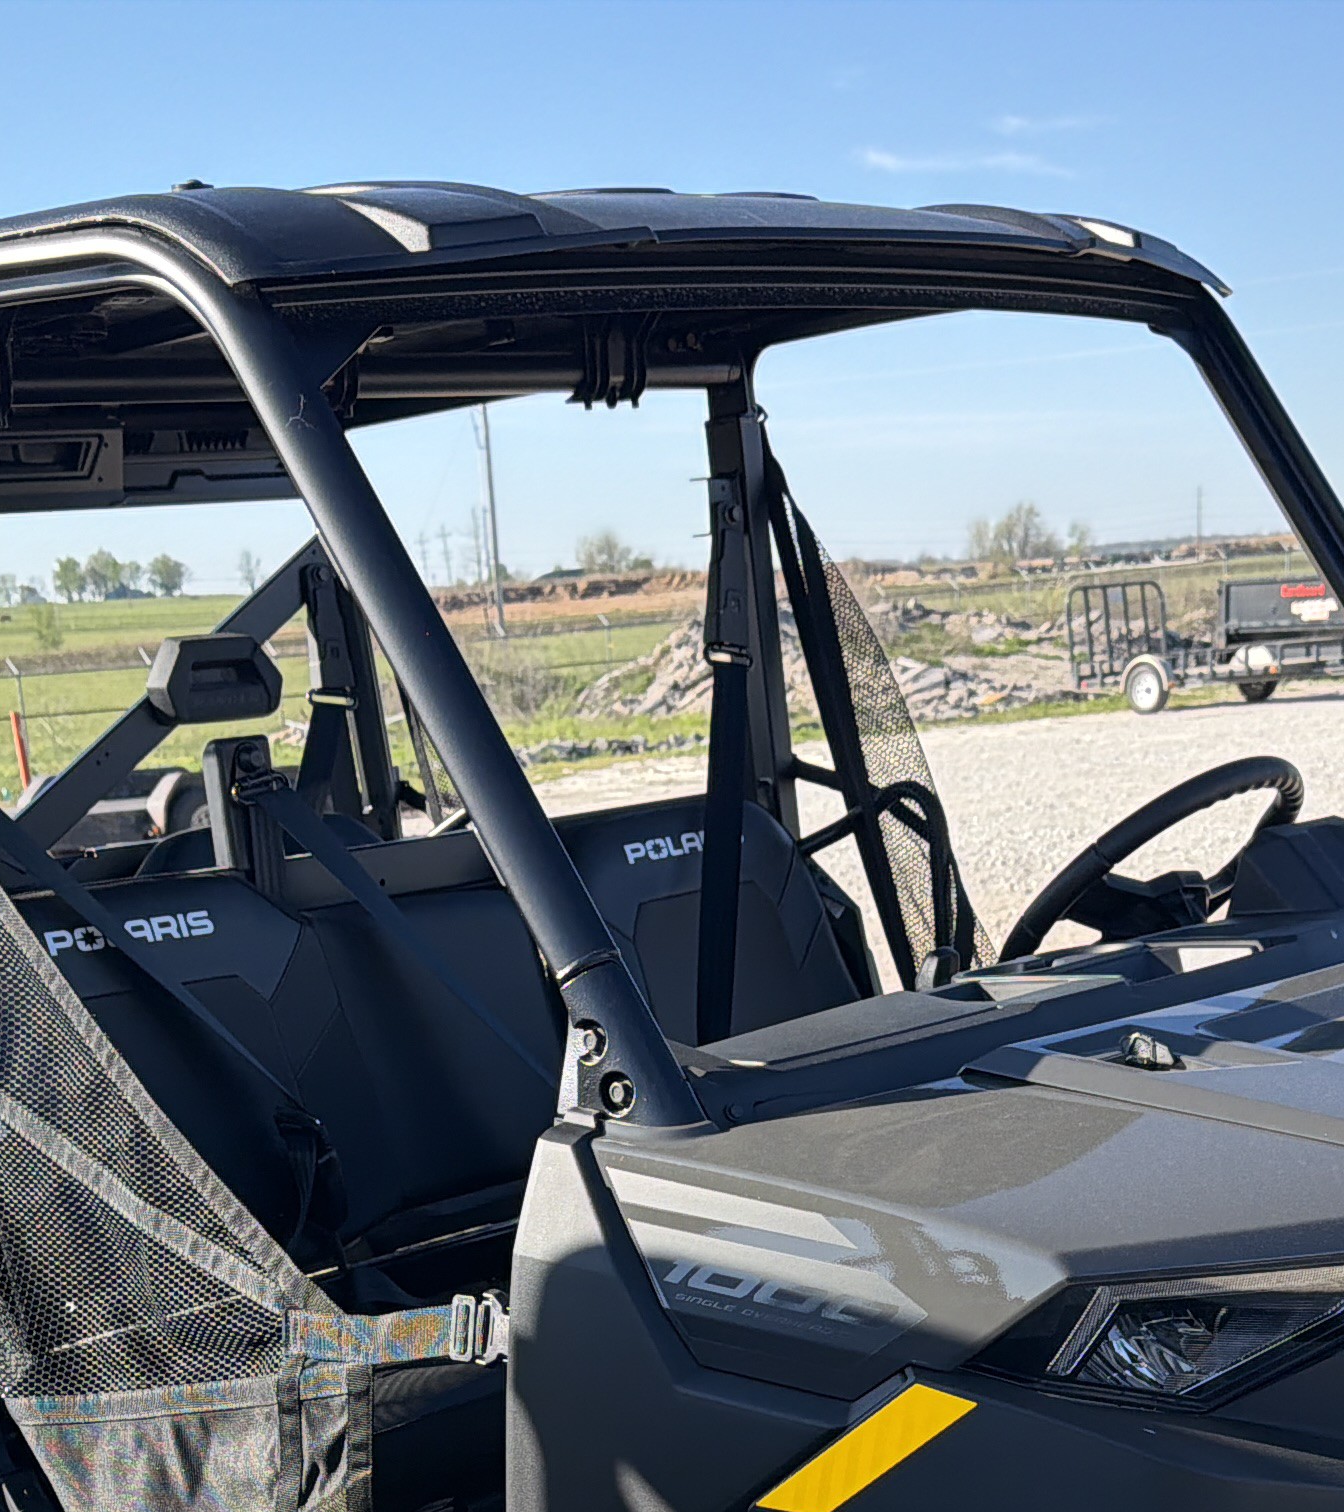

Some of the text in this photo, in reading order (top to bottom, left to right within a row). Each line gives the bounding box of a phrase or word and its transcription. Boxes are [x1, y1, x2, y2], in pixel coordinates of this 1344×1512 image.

[623, 830, 745, 865] POLA
[43, 910, 215, 957] POARIS
[662, 1258, 900, 1330] 1000
[674, 1292, 736, 1313] SINGLE
